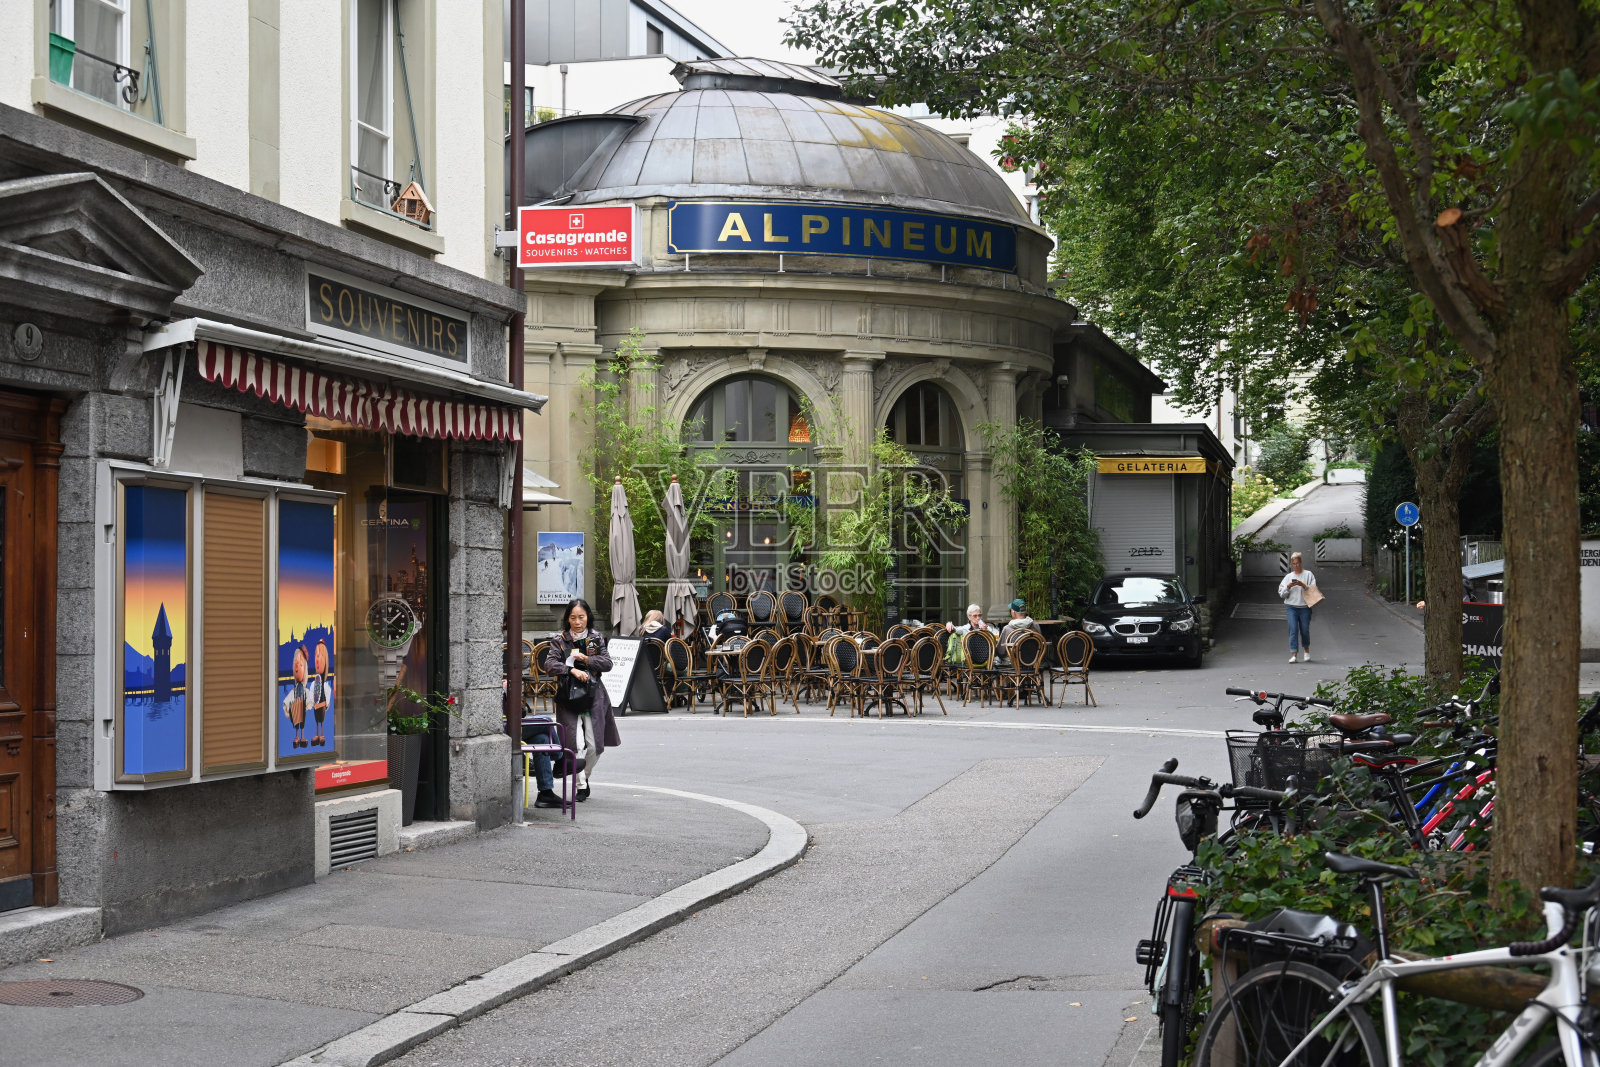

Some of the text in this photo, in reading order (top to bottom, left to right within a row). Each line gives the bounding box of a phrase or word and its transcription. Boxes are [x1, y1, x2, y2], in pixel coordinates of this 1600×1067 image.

[525, 229, 628, 246] Casagrande
[717, 212, 992, 259] ALPINEUM
[525, 246, 628, 257] SOUVENIRS WATCHES
[319, 282, 459, 357] SOUVENIRS
[26, 326, 33, 346] 9
[1117, 463, 1188, 472] GELATERIA
